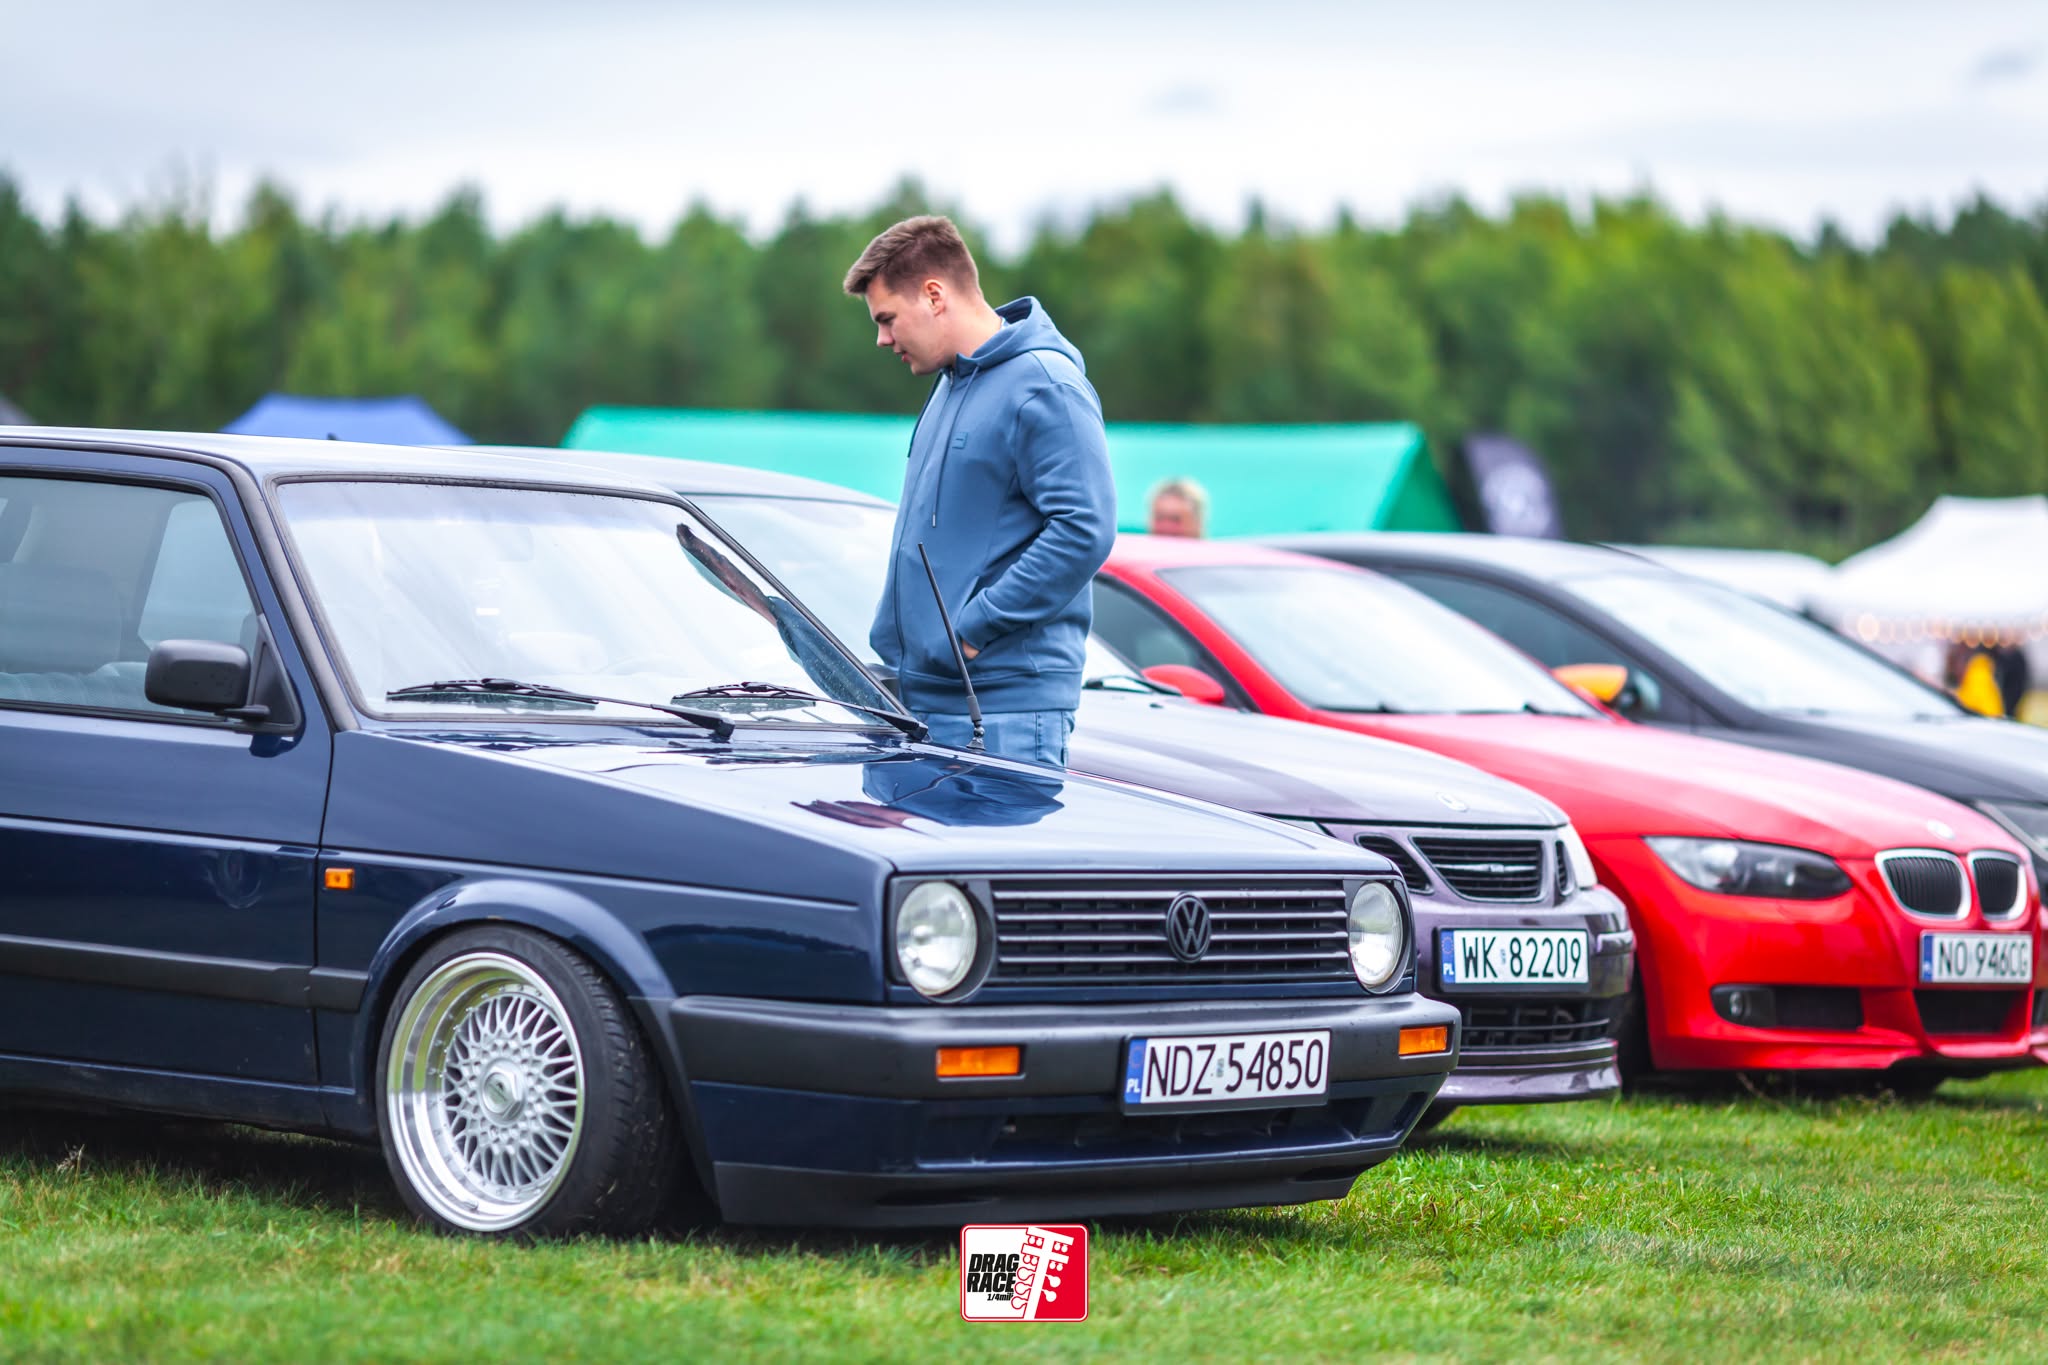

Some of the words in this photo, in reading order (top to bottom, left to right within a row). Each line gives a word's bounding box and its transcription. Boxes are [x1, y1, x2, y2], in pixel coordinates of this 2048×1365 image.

[1443, 963, 1455, 976] PL
[1462, 936, 1498, 979] WK
[1510, 937, 1582, 979] 82209
[1938, 941, 1967, 976] NO
[1126, 1078, 1141, 1093] PL
[1146, 1044, 1216, 1097] NDZ
[1225, 1039, 1324, 1093] 54850
